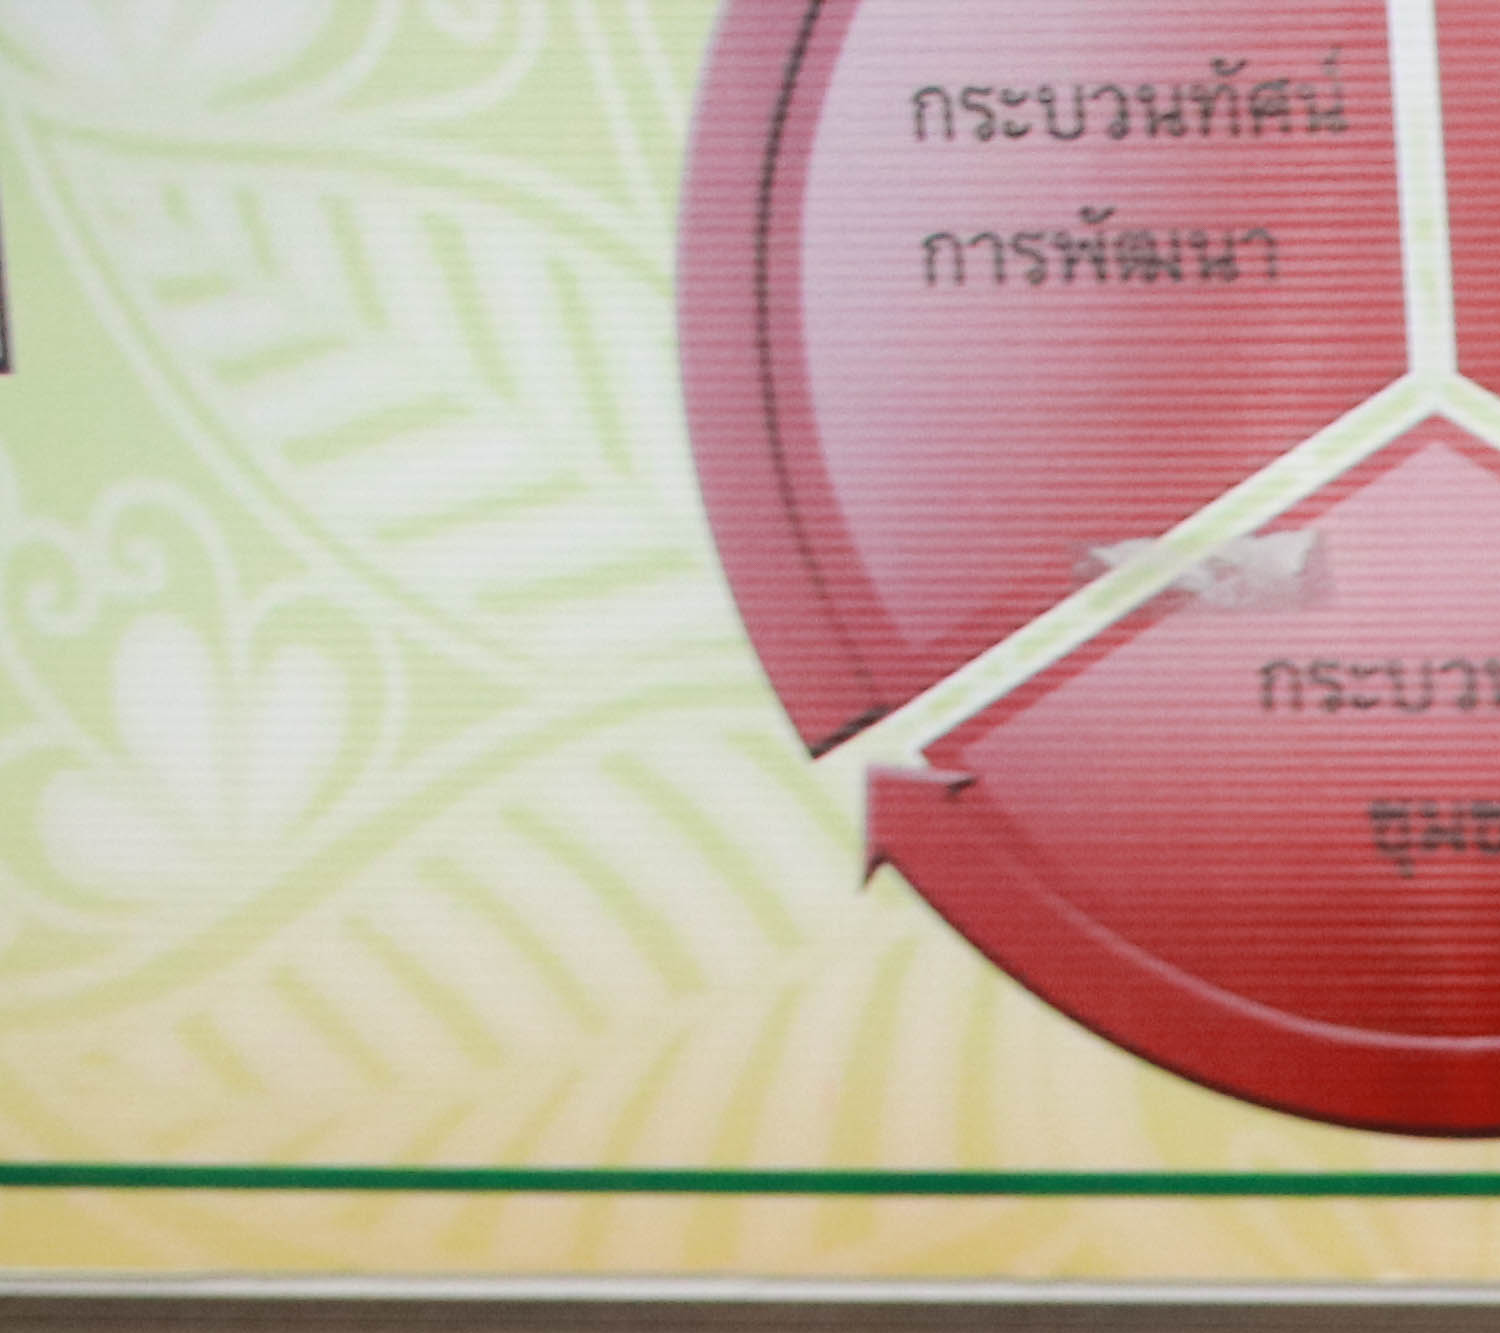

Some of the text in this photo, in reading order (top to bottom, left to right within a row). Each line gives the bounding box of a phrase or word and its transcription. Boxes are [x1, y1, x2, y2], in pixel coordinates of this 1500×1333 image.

[911, 45, 1350, 141] กระบวนทัศน์
[921, 205, 1280, 286] การพัฒนา
